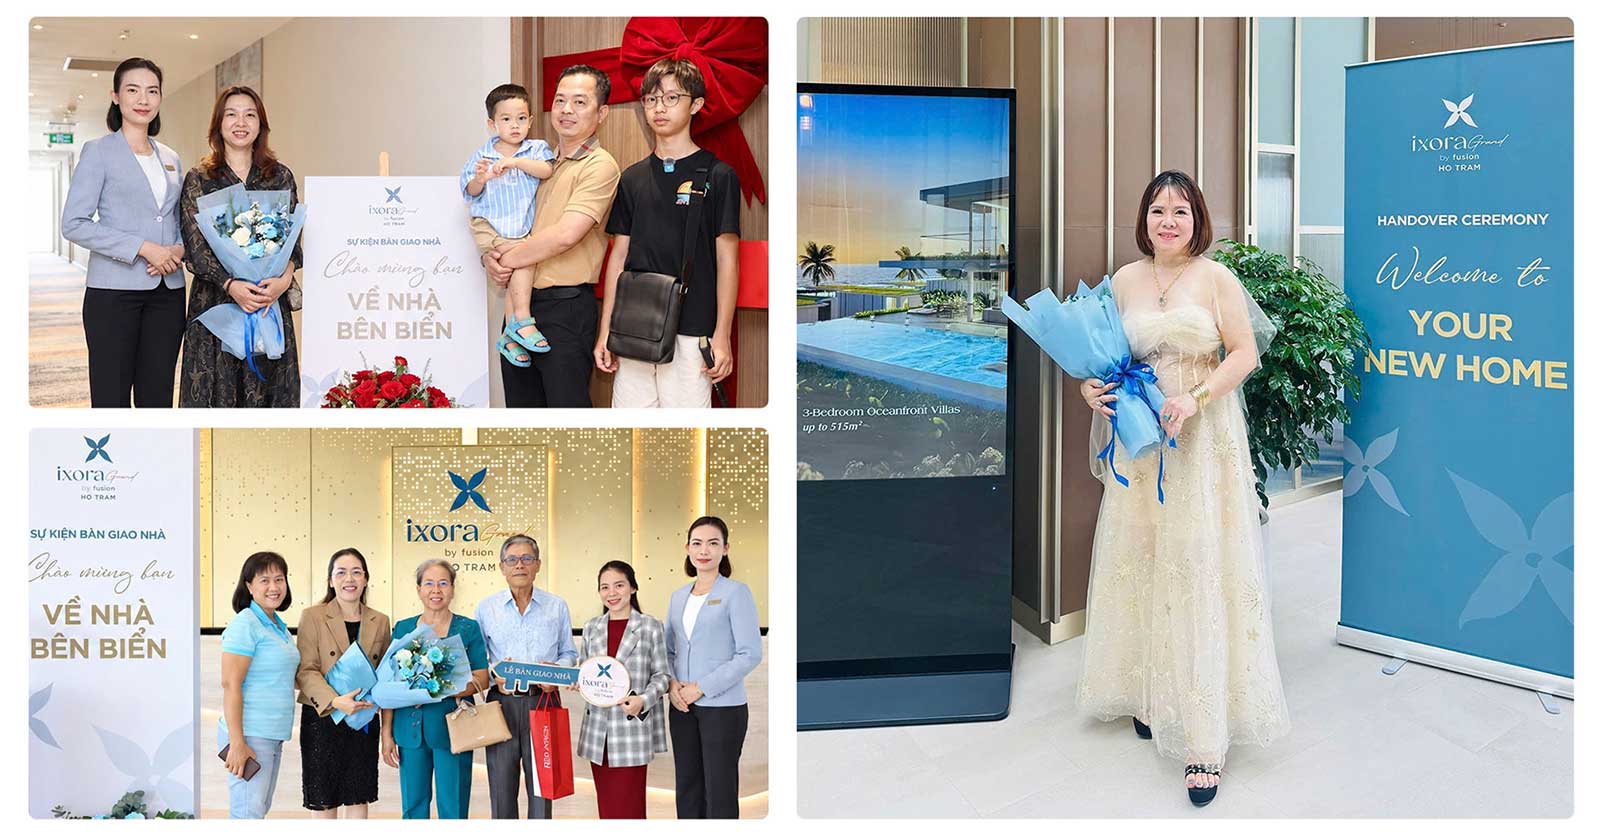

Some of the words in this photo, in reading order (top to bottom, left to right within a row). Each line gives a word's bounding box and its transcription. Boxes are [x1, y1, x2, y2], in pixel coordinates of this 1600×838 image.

[1411, 135, 1467, 151] ixora
[1467, 134, 1510, 151] Grand
[1439, 154, 1449, 162] by
[1452, 153, 1480, 161] fusion
[368, 204, 398, 215] ixora
[1377, 214, 1458, 226] HANDOVER
[1461, 213, 1549, 226] CEREMONY
[347, 237, 359, 246] SỰ
[360, 236, 379, 246] KIỆN
[380, 237, 398, 246] BÀN
[400, 238, 421, 246] GIAO
[422, 236, 441, 246] NHÀ
[1376, 246, 1503, 291] Welcome
[1517, 257, 1551, 288] to
[347, 285, 380, 311] VỀ
[388, 288, 442, 311] NHÀ
[337, 316, 387, 340] BÊN
[395, 311, 452, 340] BIỂN
[1408, 309, 1513, 342] YOUR
[1364, 348, 1447, 379] NEW
[1456, 354, 1568, 390] HOME
[802, 408, 864, 418] 3-Bedroom
[866, 405, 928, 417] Oceanfront
[931, 404, 961, 415] Villas
[802, 423, 815, 433] up
[818, 422, 828, 431] to
[57, 466, 105, 481] ixora
[30, 528, 47, 541] SỰ
[49, 527, 77, 541] KIỆN
[80, 527, 105, 539] BÀN
[108, 530, 138, 540] GIAO
[140, 528, 166, 540] NHÀ
[406, 518, 479, 542] ixora
[444, 548, 457, 558] by
[461, 548, 494, 557] fusion
[463, 563, 496, 571] TRAM
[42, 595, 82, 625] VỀ
[91, 598, 155, 625] NHÀ
[31, 632, 89, 659] BÊN
[99, 627, 167, 659] BIỂN
[532, 670, 553, 678] GIAO
